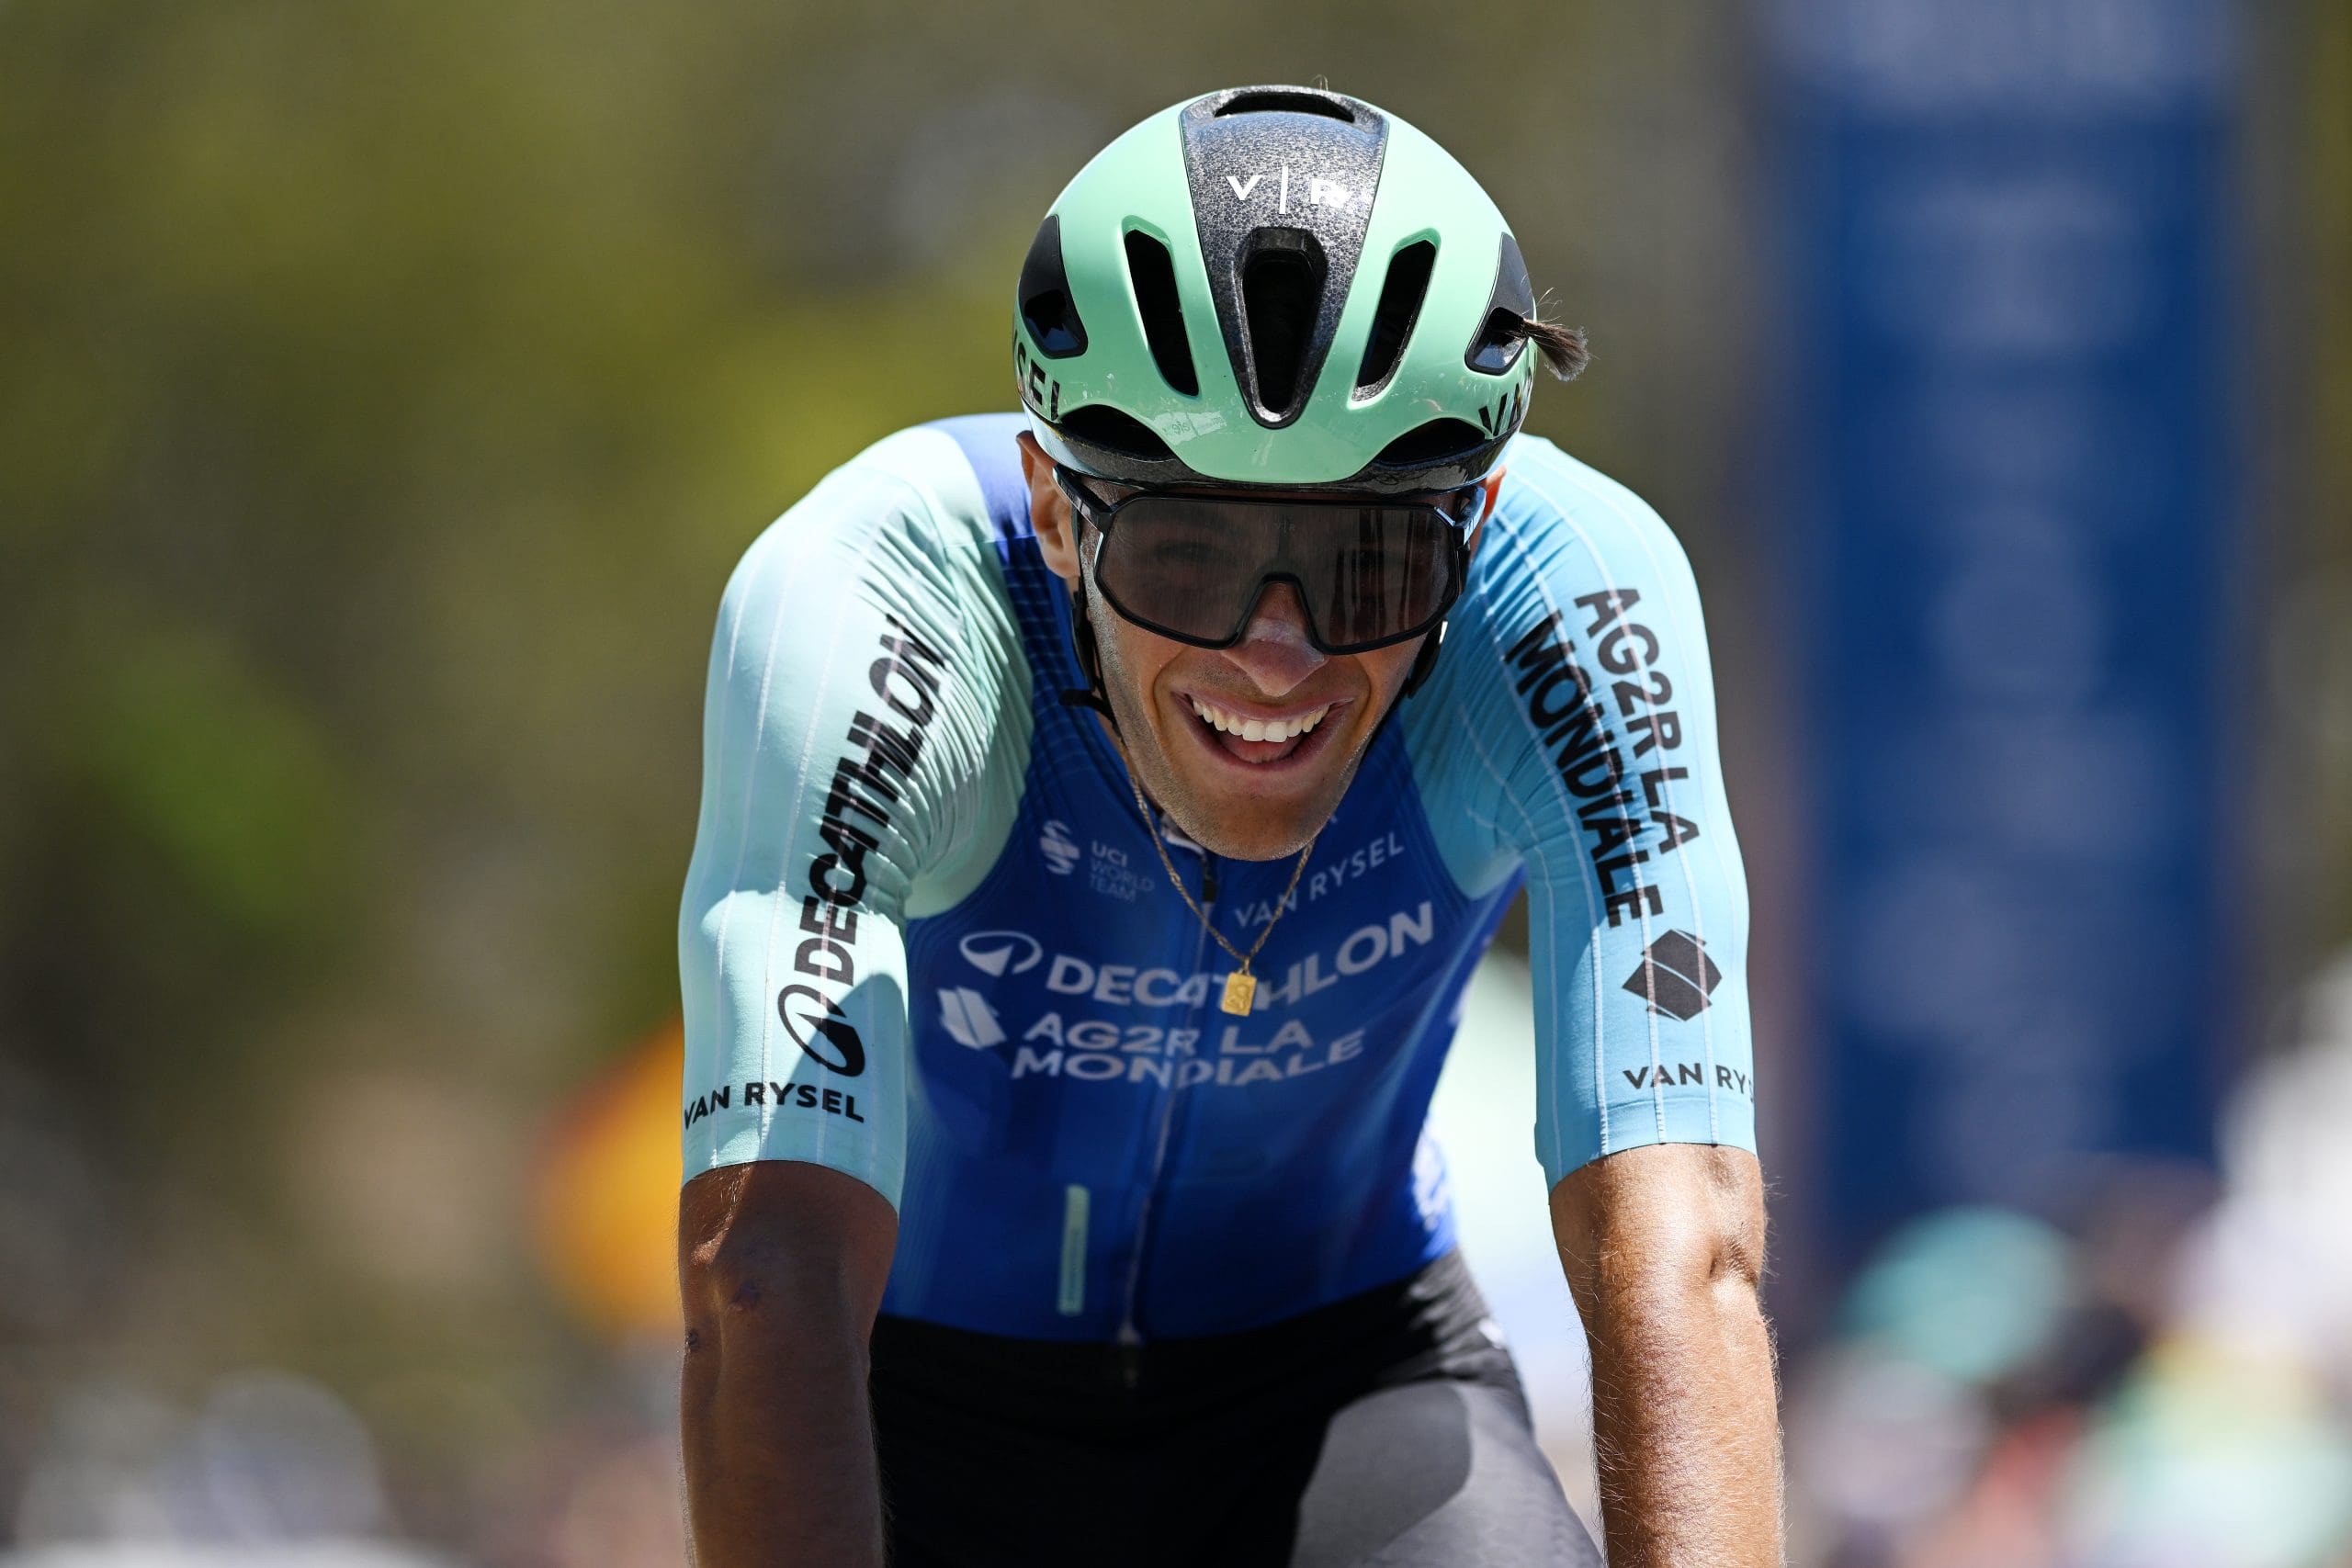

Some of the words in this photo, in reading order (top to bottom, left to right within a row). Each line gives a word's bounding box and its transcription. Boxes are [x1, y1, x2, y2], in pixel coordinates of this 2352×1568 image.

[1574, 588, 1683, 760] AG2R
[1639, 765, 1700, 855] LA
[1503, 607, 1664, 929] MONDIALE
[794, 612, 947, 987] DECATHLON
[1091, 840, 1128, 868] UCI
[1234, 888, 1298, 929] VAN
[1309, 830, 1406, 902] RYSEL
[1011, 1028, 1367, 1090] MONDIALE
[1023, 1012, 1200, 1055] AG2R
[1219, 1019, 1316, 1055] LA
[684, 1083, 731, 1130] VAN
[743, 1081, 865, 1123] RYSEL
[1622, 1062, 1703, 1090] VAN
